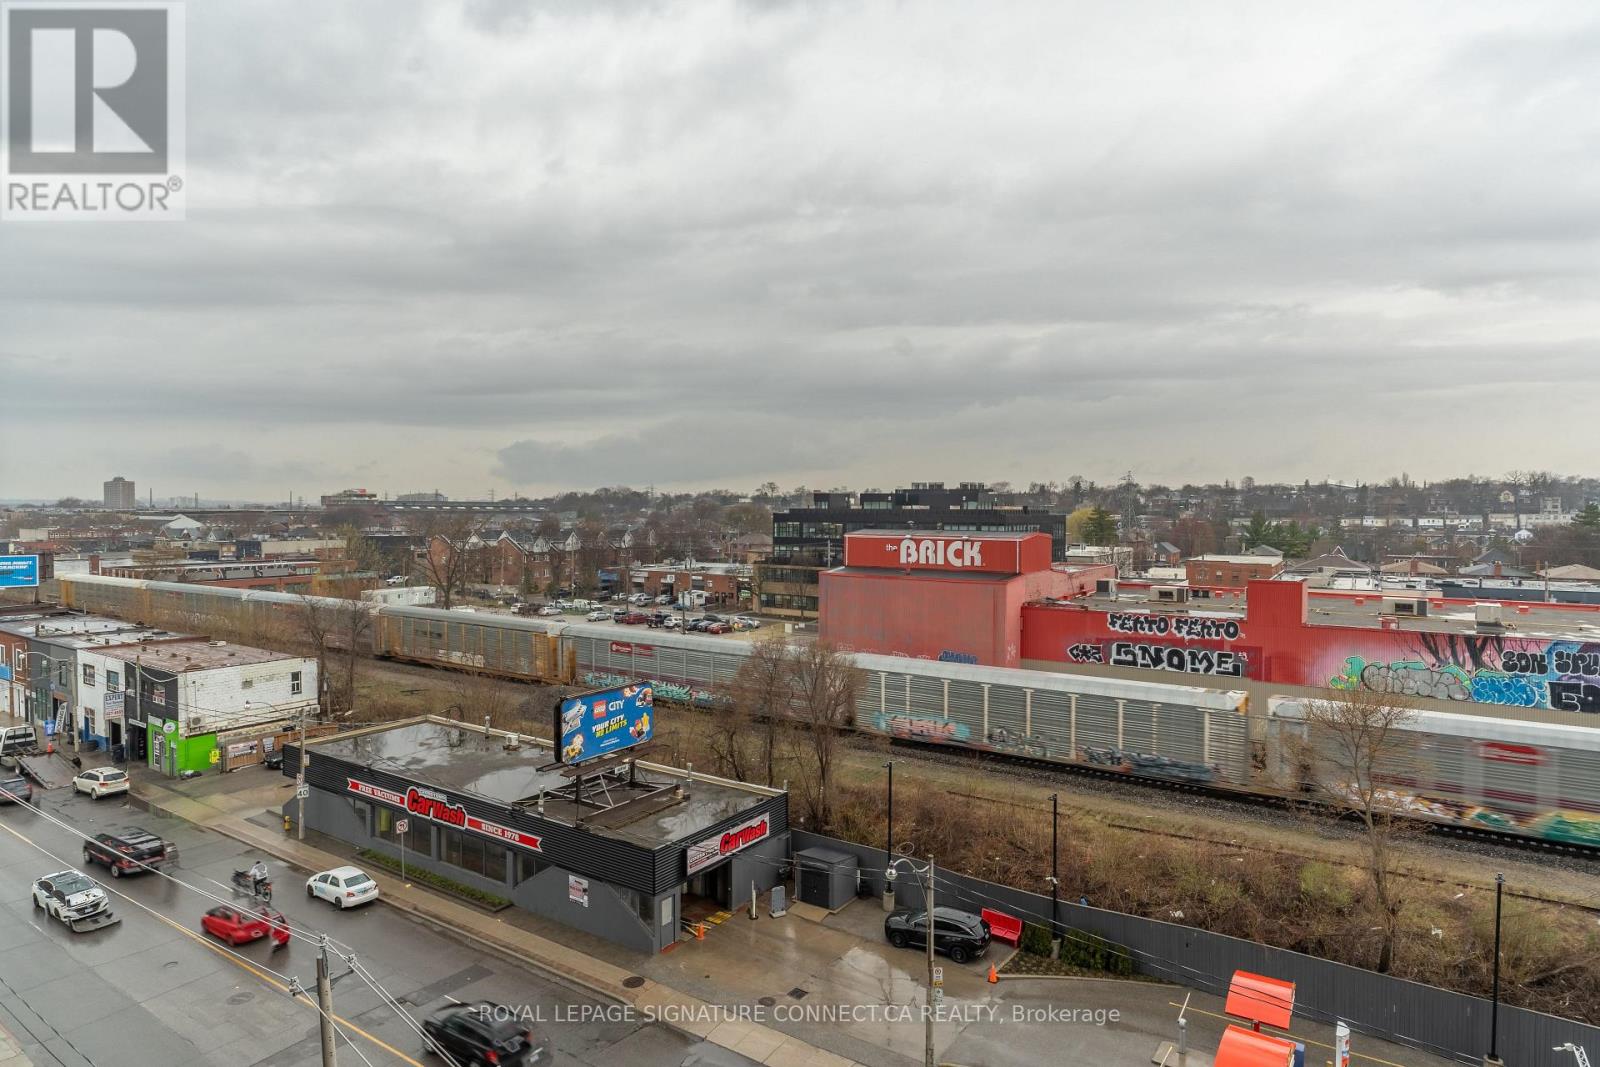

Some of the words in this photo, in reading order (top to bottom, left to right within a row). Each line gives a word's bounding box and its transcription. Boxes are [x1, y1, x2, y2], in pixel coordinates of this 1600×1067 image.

[885, 543, 898, 551] the
[899, 539, 983, 567] BRICK
[1110, 641, 1242, 678] GNOME
[609, 700, 625, 711] CITY
[592, 721, 609, 733] YOUR
[609, 713, 625, 724] CITY
[606, 720, 627, 733] LIMITS
[297, 789, 309, 797] 40
[481, 822, 503, 837] SINCE
